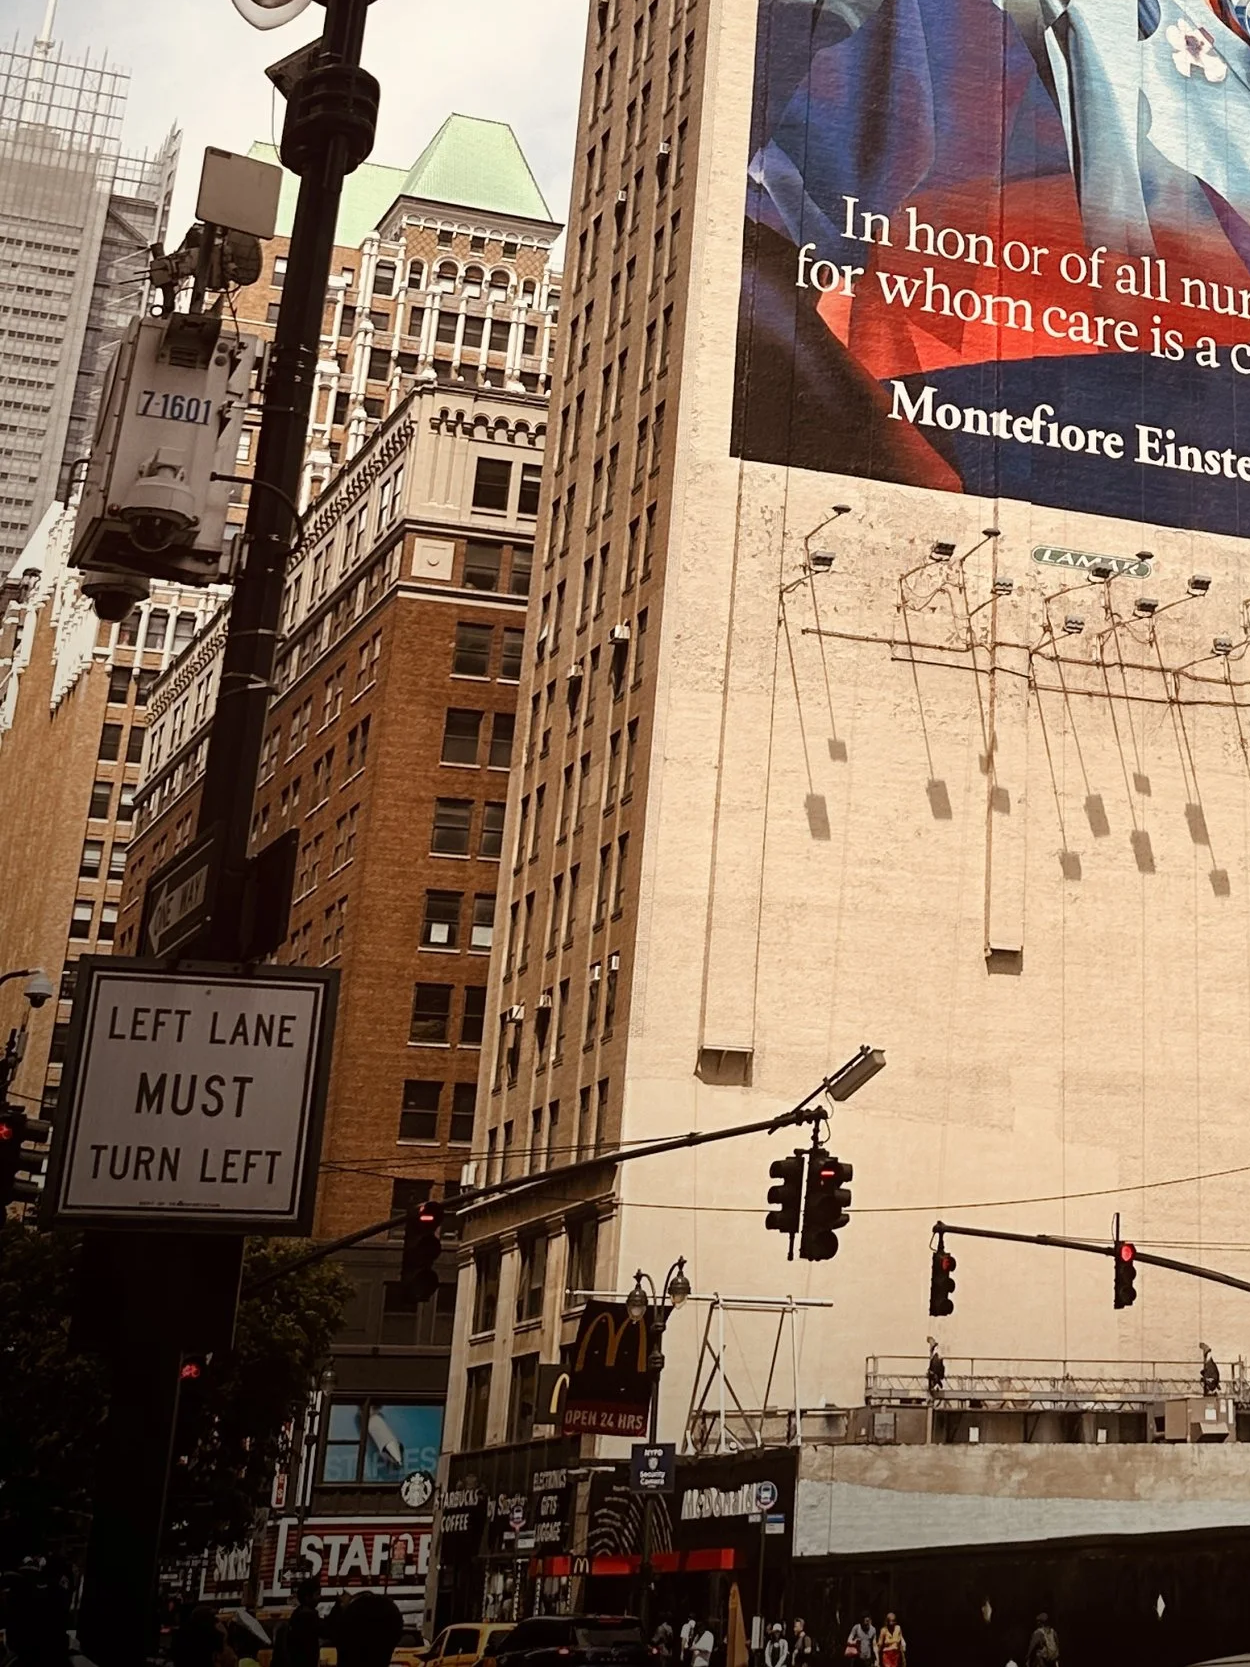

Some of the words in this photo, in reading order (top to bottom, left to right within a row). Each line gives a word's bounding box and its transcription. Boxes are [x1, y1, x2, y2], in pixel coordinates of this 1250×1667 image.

[841, 195, 893, 247] In
[904, 207, 1049, 275] honor
[1060, 246, 1107, 288] of
[1115, 256, 1171, 302] all
[796, 243, 864, 297] for
[876, 267, 1034, 332] whom
[1042, 306, 1139, 352] care
[1150, 315, 1185, 361] is
[1195, 336, 1220, 369] a
[142, 390, 212, 425] 7-1601
[887, 380, 1125, 459] Montefiore
[109, 1006, 191, 1042] LEFT
[209, 1012, 297, 1048] LANE
[135, 1072, 253, 1118] MUST
[90, 1144, 181, 1182] TURN
[200, 1149, 282, 1185] LEFT
[564, 1409, 597, 1427] OPEN
[599, 1412, 615, 1428] 24
[617, 1413, 645, 1431] HRS
[441, 1513, 469, 1533] COFFEE
